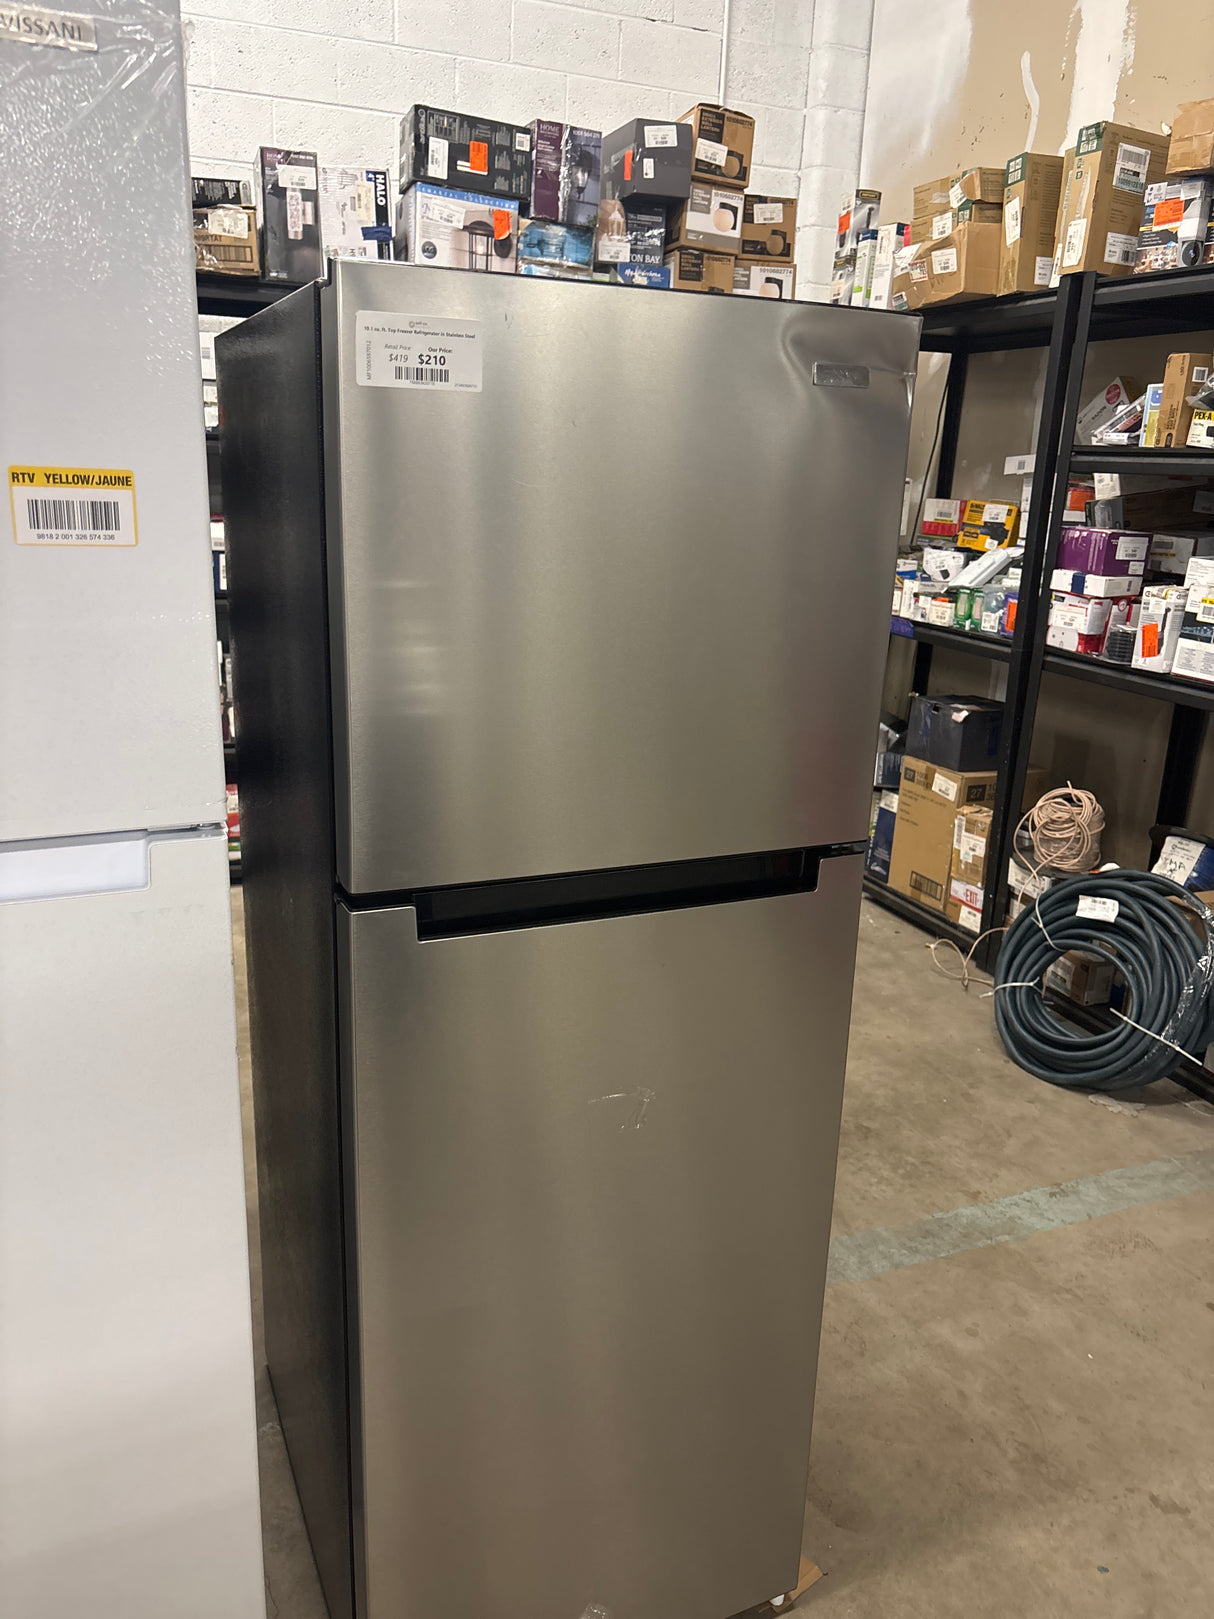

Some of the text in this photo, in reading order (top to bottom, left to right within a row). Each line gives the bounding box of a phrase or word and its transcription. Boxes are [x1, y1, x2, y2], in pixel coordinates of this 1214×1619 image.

[539, 123, 560, 132] HOME
[375, 174, 386, 206] HALO
[645, 254, 661, 264] BAY
[388, 353, 409, 363] $419
[418, 353, 446, 366] $210
[1194, 411, 1212, 421] PEX-A
[11, 472, 132, 487] RTV YELLOW/JAUNE
[970, 788, 981, 799] 27
[965, 888, 978, 906] EXIT
